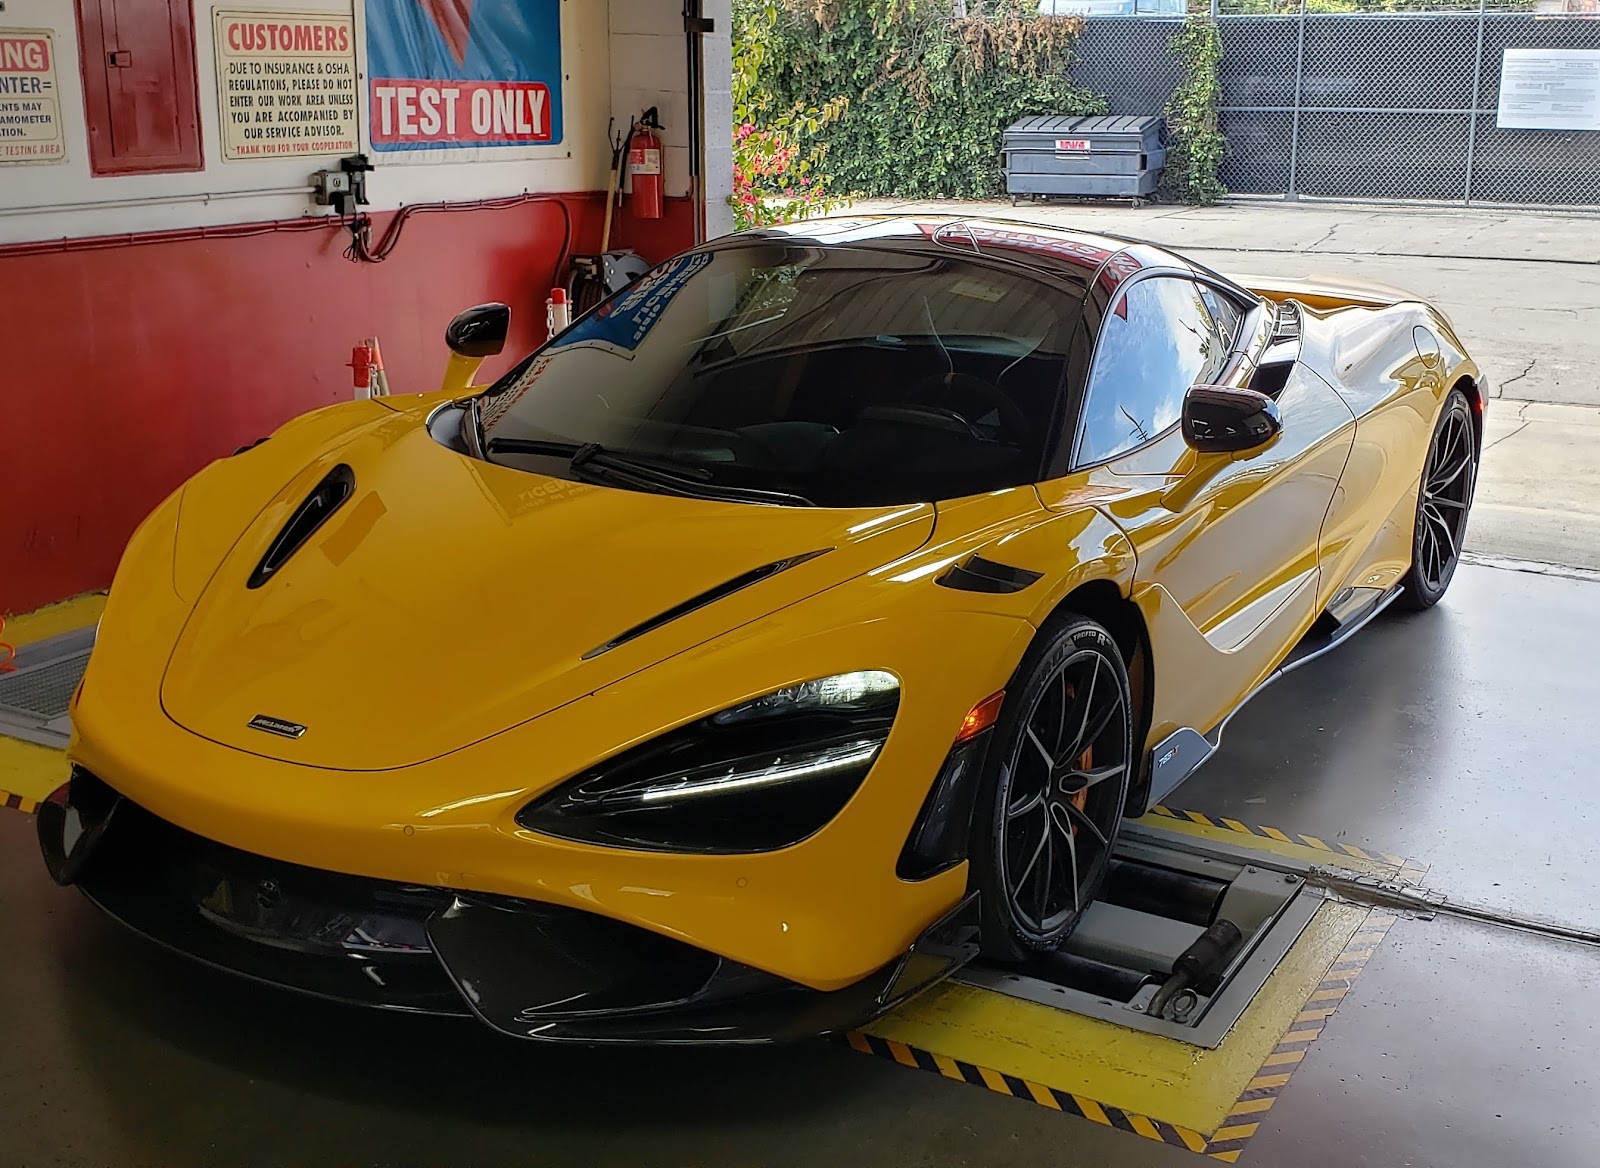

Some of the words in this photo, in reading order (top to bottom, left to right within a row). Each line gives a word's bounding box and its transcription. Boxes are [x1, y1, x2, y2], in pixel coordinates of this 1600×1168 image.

[228, 23, 349, 51] CUSTOMERS
[229, 62, 247, 75] DUE
[249, 63, 261, 75] TO
[264, 63, 314, 75] INSURANCE
[317, 63, 323, 75] &
[325, 63, 350, 75] OSHA
[229, 79, 290, 92] REGULATIONS,
[292, 79, 320, 91] PLEASE
[323, 79, 334, 90] DO
[337, 79, 352, 90] NOT
[22, 102, 42, 112] MAY
[229, 95, 254, 108] ENTER
[258, 95, 274, 107] OUR
[278, 95, 302, 107] WORK
[306, 95, 325, 106] AREA
[328, 94, 353, 105] UNLESS
[231, 111, 250, 123] YOU
[255, 111, 273, 123] ARE
[278, 110, 339, 122] ACCOMPANIED
[343, 109, 354, 120] BY
[376, 87, 460, 136] TEST
[471, 88, 546, 136] ONLY
[244, 128, 263, 139] OUR
[266, 126, 301, 138] SERVICE
[304, 125, 345, 137] ADVISOR.
[5, 145, 37, 156] TESTING
[39, 144, 60, 154] AREA
[237, 145, 260, 155] THANK
[263, 144, 276, 154] YOU
[278, 144, 290, 153] FOR
[292, 143, 310, 152] YOUR
[312, 141, 353, 151] COOPERATION
